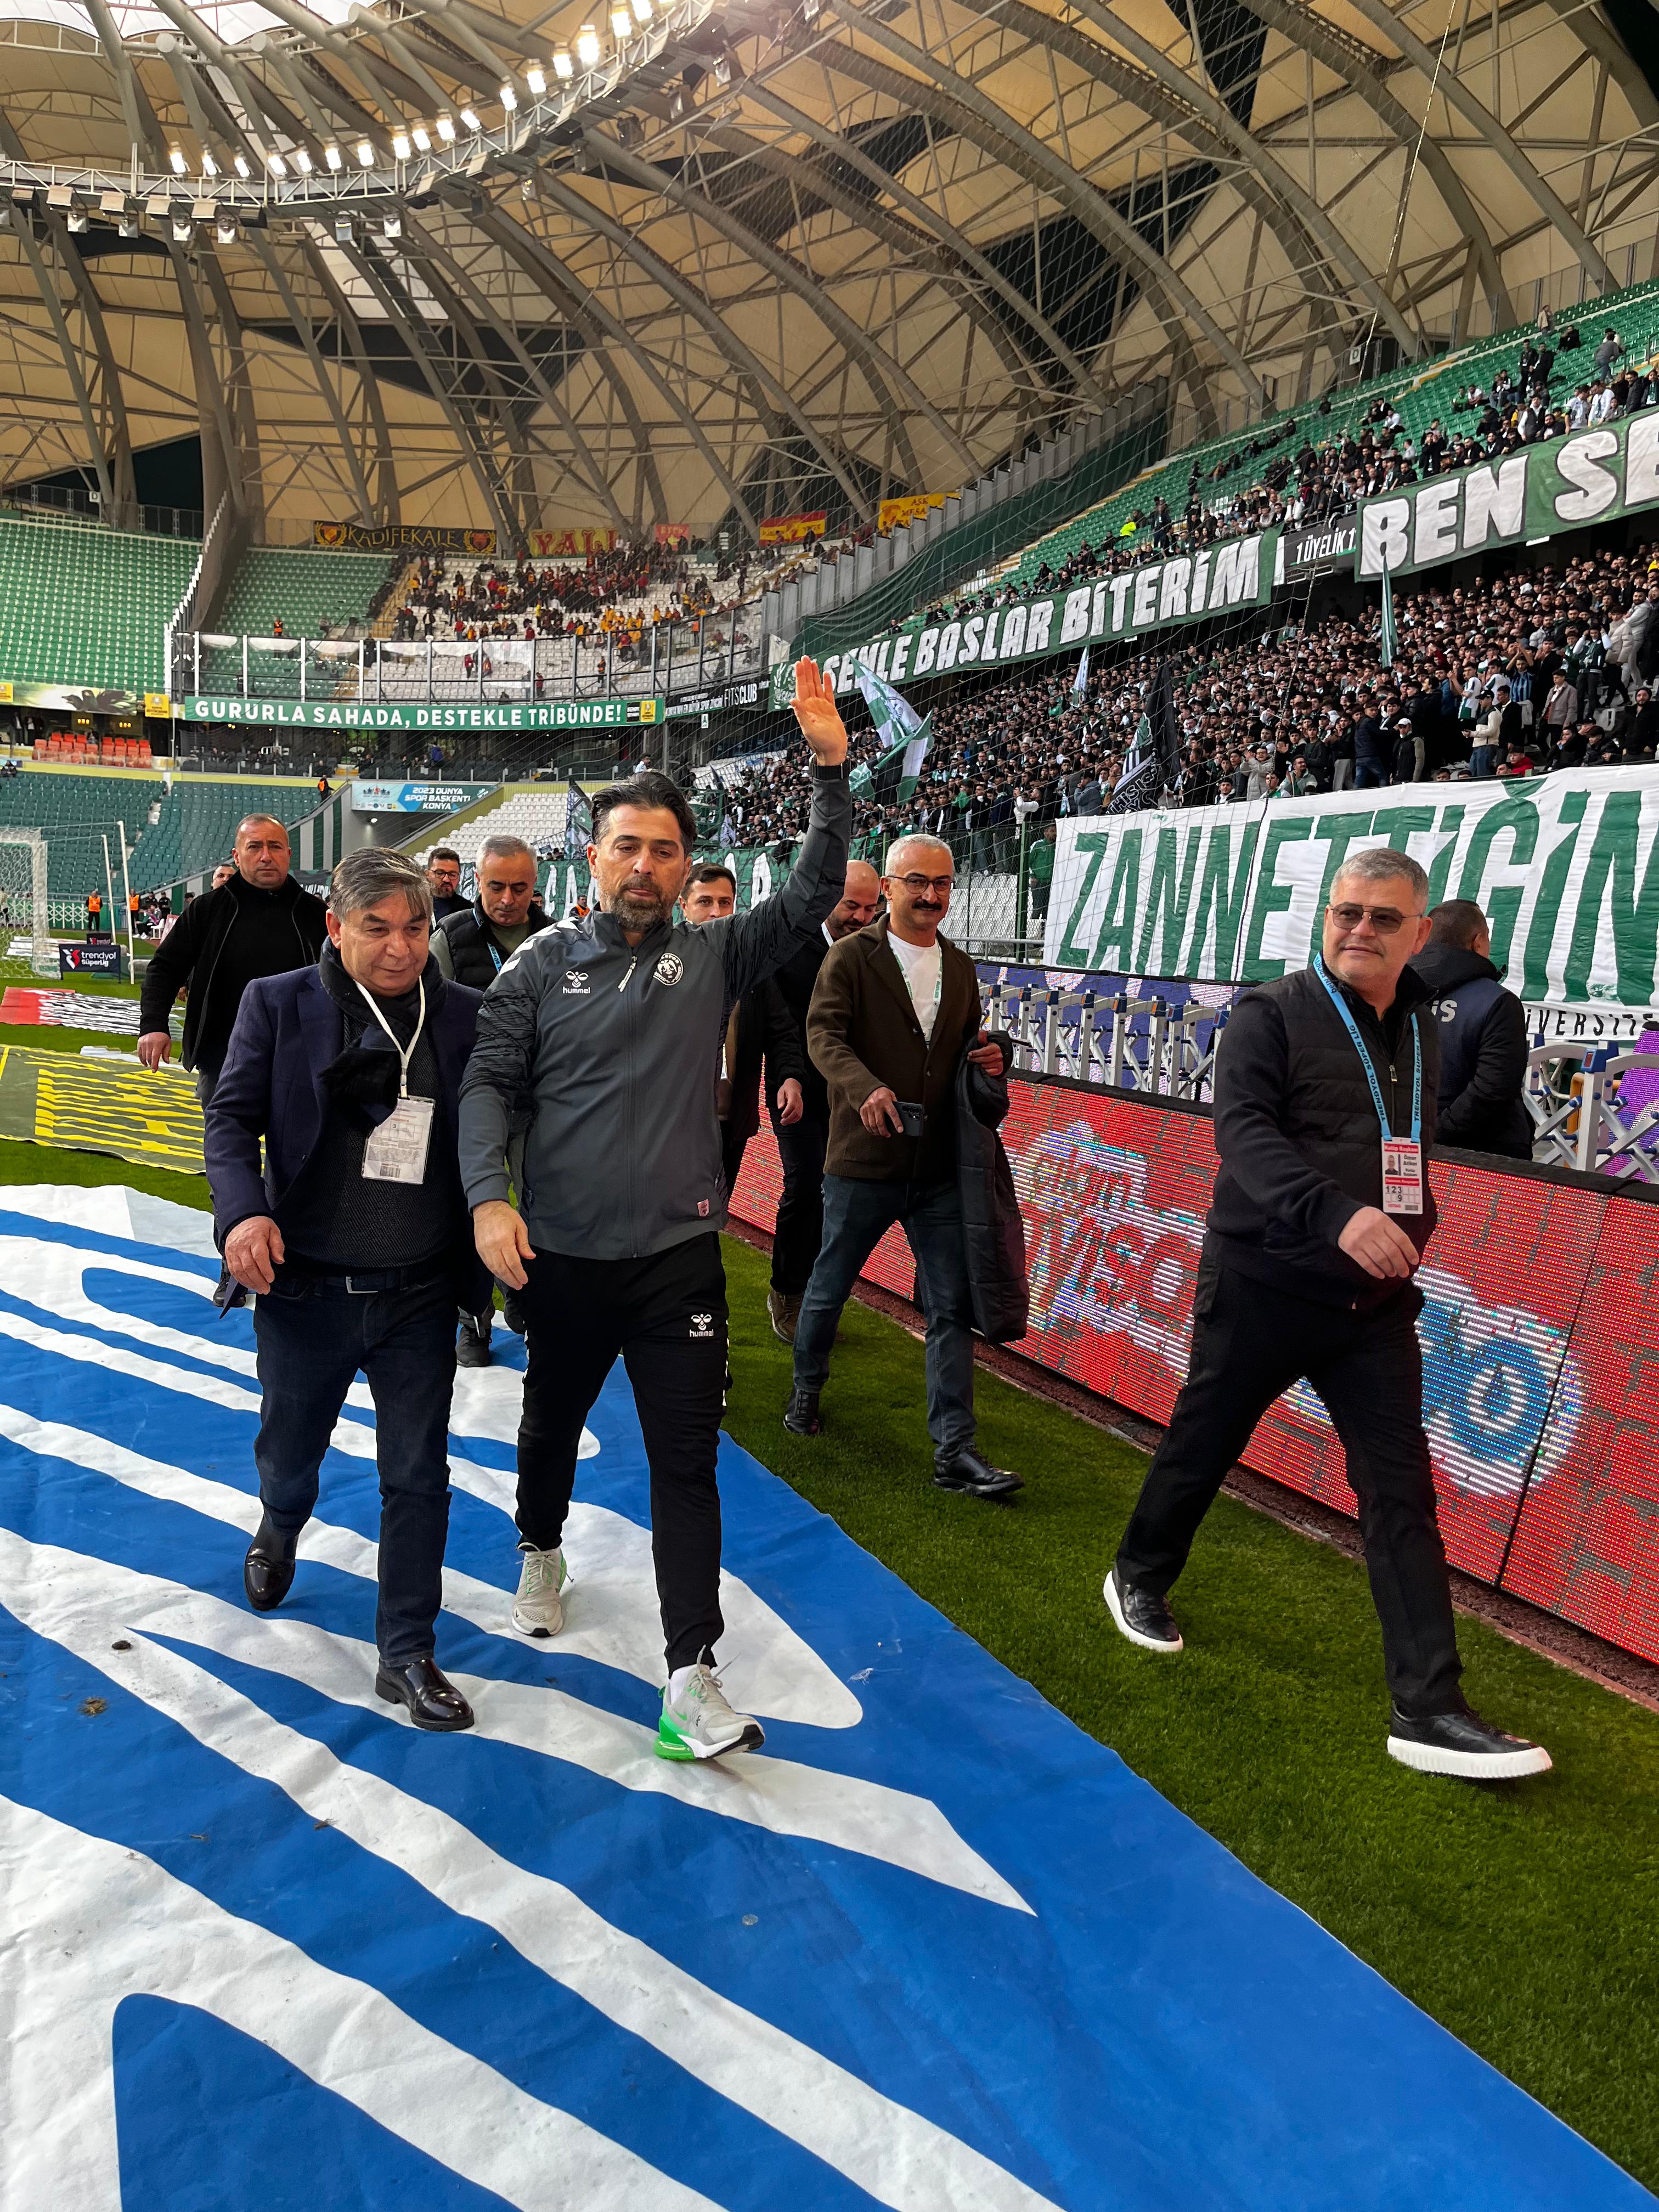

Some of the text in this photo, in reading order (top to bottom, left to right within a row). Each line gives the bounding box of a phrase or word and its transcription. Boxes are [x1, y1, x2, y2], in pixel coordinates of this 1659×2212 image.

[1359, 454, 1530, 575] BEN
[1296, 542, 1303, 564] 1
[1304, 527, 1347, 562] ÜYELİK
[195, 701, 306, 723] GURURLA
[313, 707, 410, 729] SAHADA,
[416, 709, 522, 726] DESTEKLE
[528, 703, 621, 725] TRİBÜNDE!
[81, 951, 116, 960] trendyol
[1357, 1040, 1372, 1070] SÜPER
[1369, 1074, 1385, 1122] TRENDYOL
[689, 1329, 714, 1337] hummel
